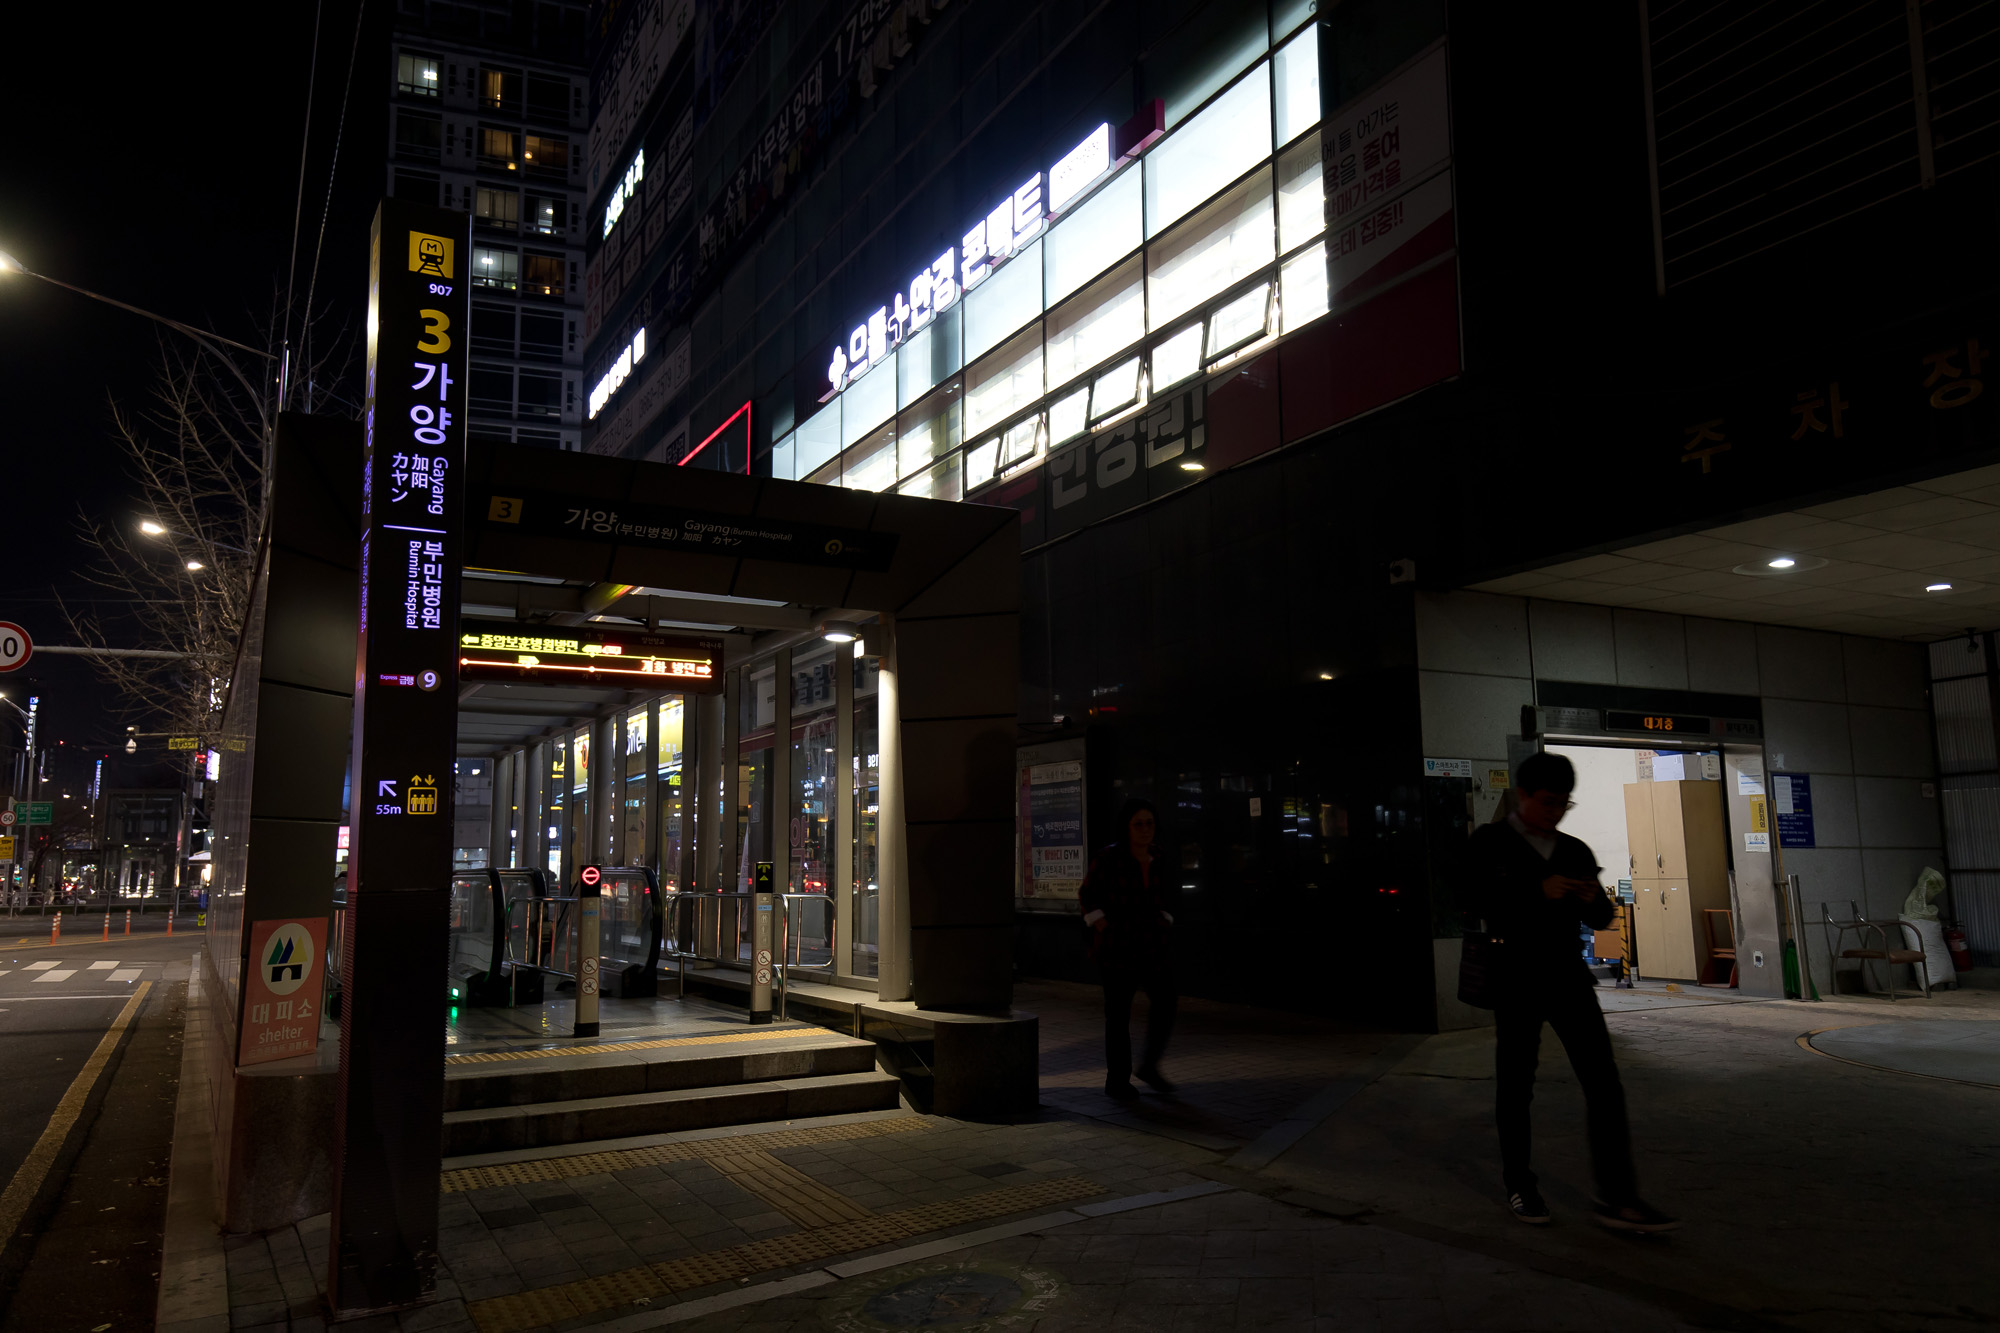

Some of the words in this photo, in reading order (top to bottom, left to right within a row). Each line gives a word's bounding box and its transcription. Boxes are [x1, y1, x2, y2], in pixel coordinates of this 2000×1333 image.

[1363, 126, 1400, 172] 줄여
[1361, 201, 1404, 246] 집중!!
[429, 283, 453, 297] 907
[416, 308, 451, 355] 3
[410, 362, 453, 445] 가양
[391, 452, 408, 503] カヤン
[411, 454, 429, 489] 加阳
[428, 456, 448, 515] Gayang
[496, 499, 513, 520] 3
[712, 536, 742, 547] カヤン
[758, 530, 792, 542] Hospital)
[408, 541, 421, 578] Bumin
[422, 541, 444, 629] 부민병원
[405, 580, 419, 629] Hospital
[424, 672, 437, 688] 9
[672, 661, 696, 676] 방면
[1644, 717, 1673, 730] 대기중
[1435, 761, 1459, 770] 스마트치과
[376, 804, 401, 815] 55m
[1064, 848, 1080, 861] GYM
[252, 998, 312, 1025] 대피소
[259, 1024, 304, 1044] shelter
